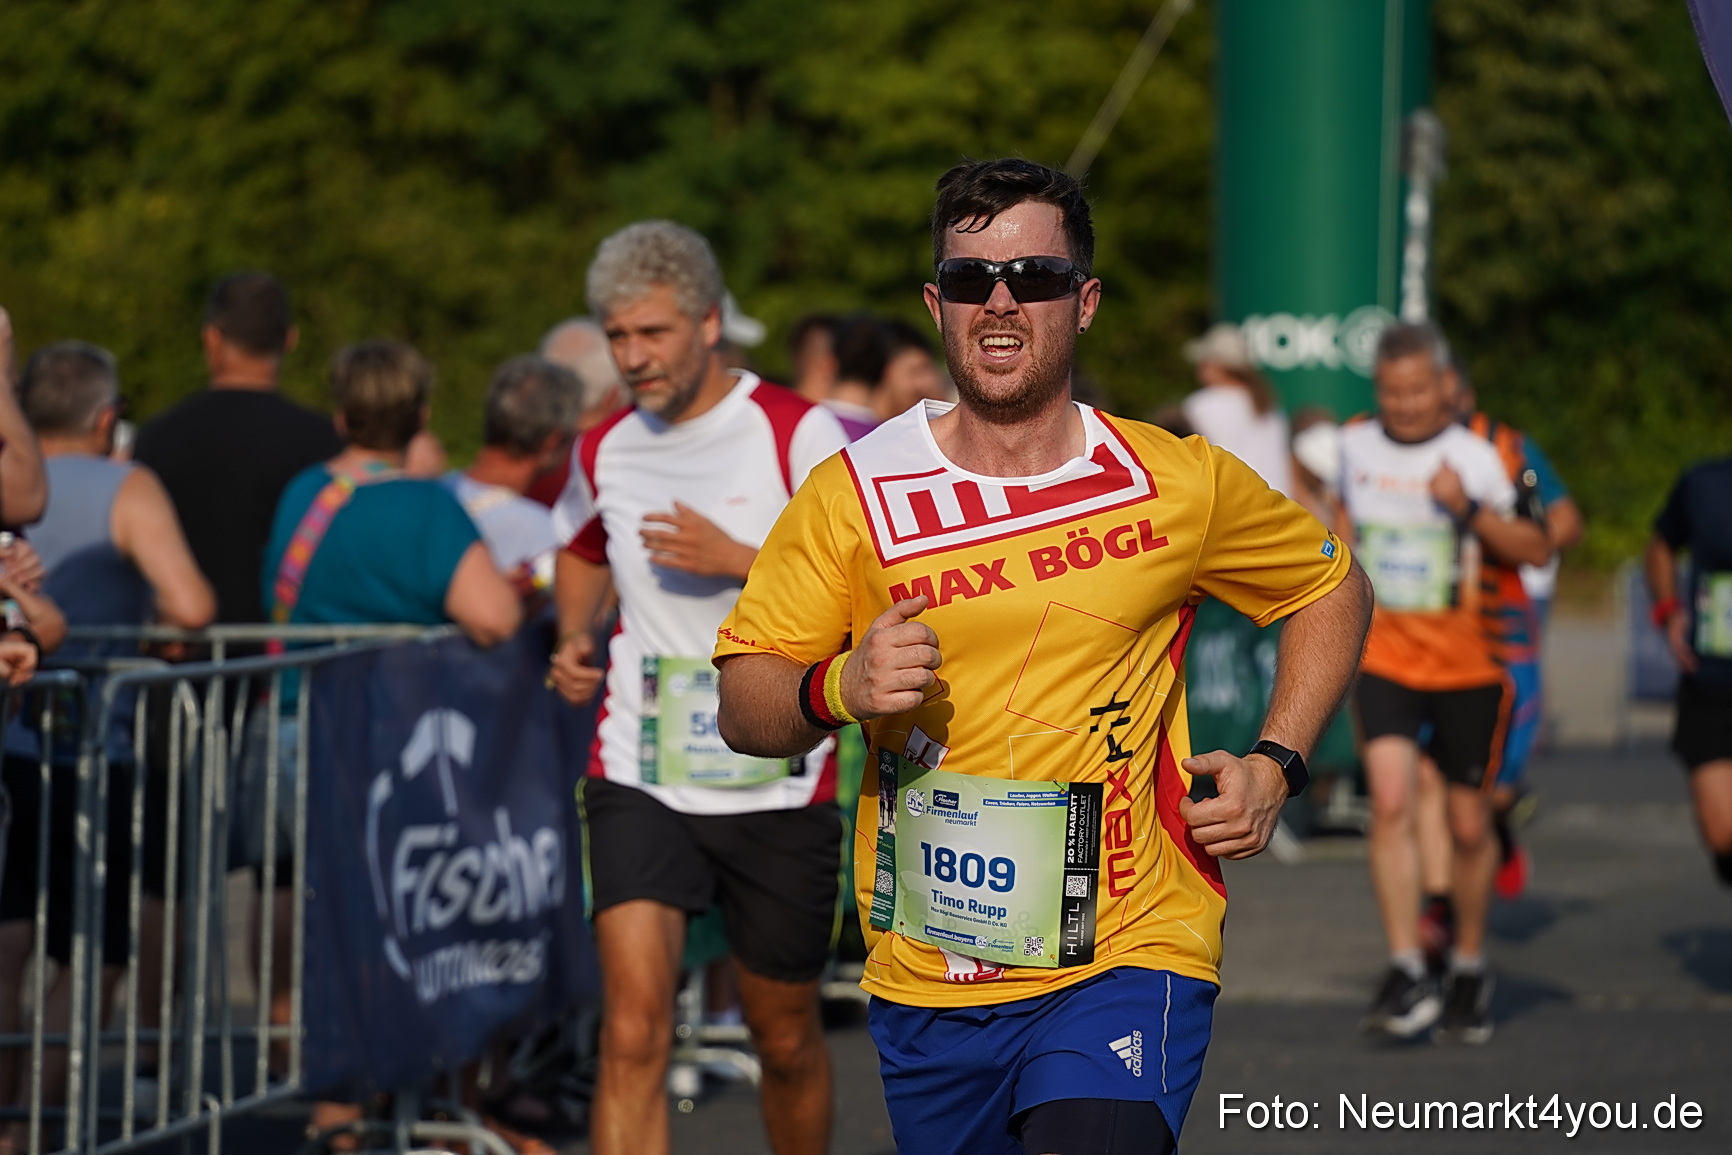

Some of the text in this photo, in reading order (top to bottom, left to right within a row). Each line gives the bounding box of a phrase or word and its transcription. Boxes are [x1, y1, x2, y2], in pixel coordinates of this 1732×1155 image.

[888, 518, 1169, 610] MAX BÖGL
[880, 763, 895, 775] AOK
[926, 805, 979, 821] Firmenlauf
[945, 818, 977, 827] neumarkt
[1067, 793, 1078, 864] 20 % RABATT
[1077, 794, 1087, 864] FACTORY OUTLET
[920, 841, 1016, 893] 1809
[931, 889, 1007, 921] Timo Rupp
[972, 917, 987, 925] GmbH
[926, 927, 974, 944] firmenlauf.bayern
[1066, 902, 1080, 956] HILTL
[1130, 1030, 1143, 1078] adidas
